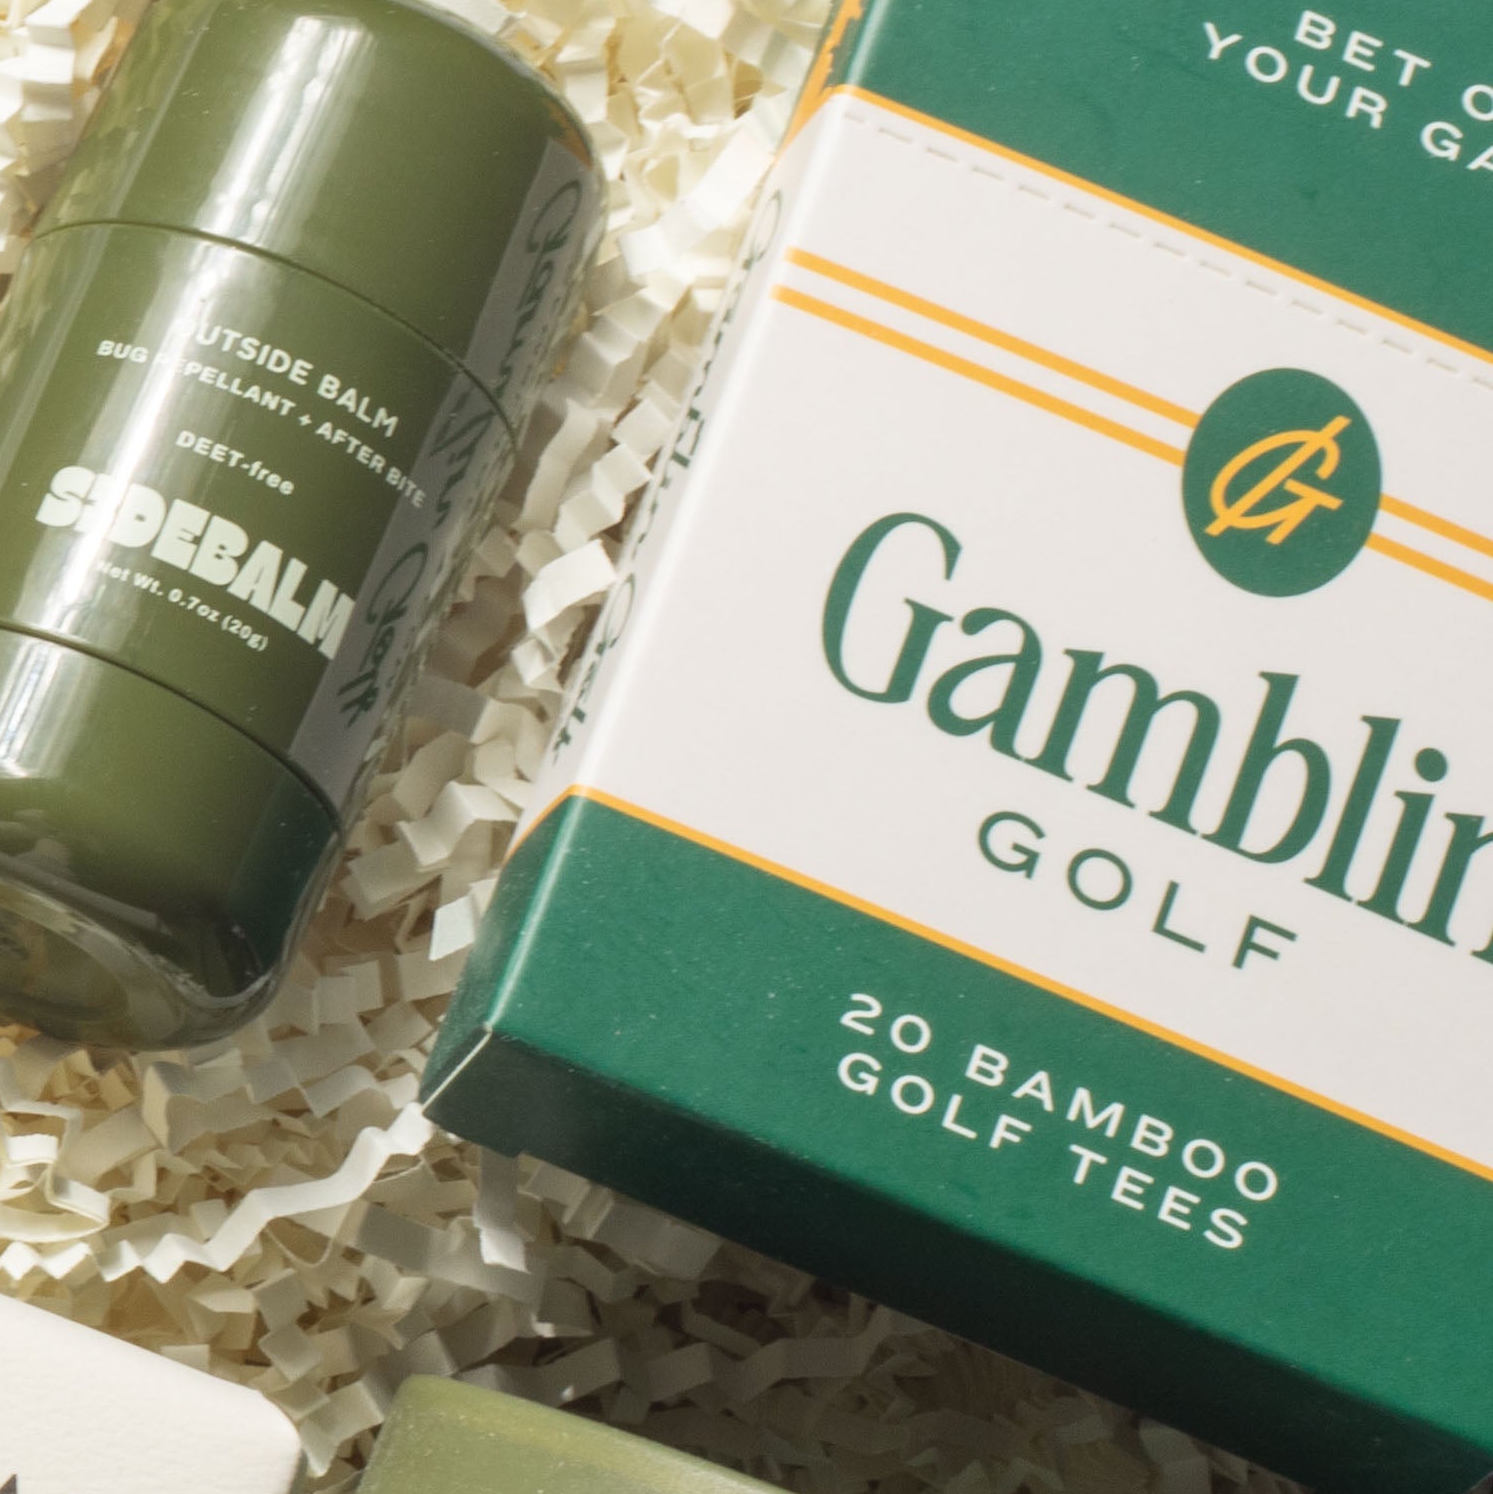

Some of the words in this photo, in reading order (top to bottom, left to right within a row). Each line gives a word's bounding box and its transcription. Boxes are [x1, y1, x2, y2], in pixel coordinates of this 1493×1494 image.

[1203, 21, 1388, 129] YOUR
[1294, 9, 1432, 87] BET
[96, 339, 150, 364] BUG
[315, 421, 386, 474] AFTER
[385, 466, 426, 508] BITE
[175, 429, 296, 496] DEET-free
[317, 374, 399, 438] BALM
[35, 465, 356, 661] SIDEBALM
[133, 571, 164, 597] Wt.
[168, 587, 221, 623] 0.7oz
[221, 614, 269, 652] (20g)
[977, 810, 1299, 971] GOLF
[837, 1052, 1032, 1150] GOLF
[1068, 1143, 1249, 1250] TEES
[839, 992, 932, 1054] 20
[965, 1043, 1279, 1202] BAMBOO
